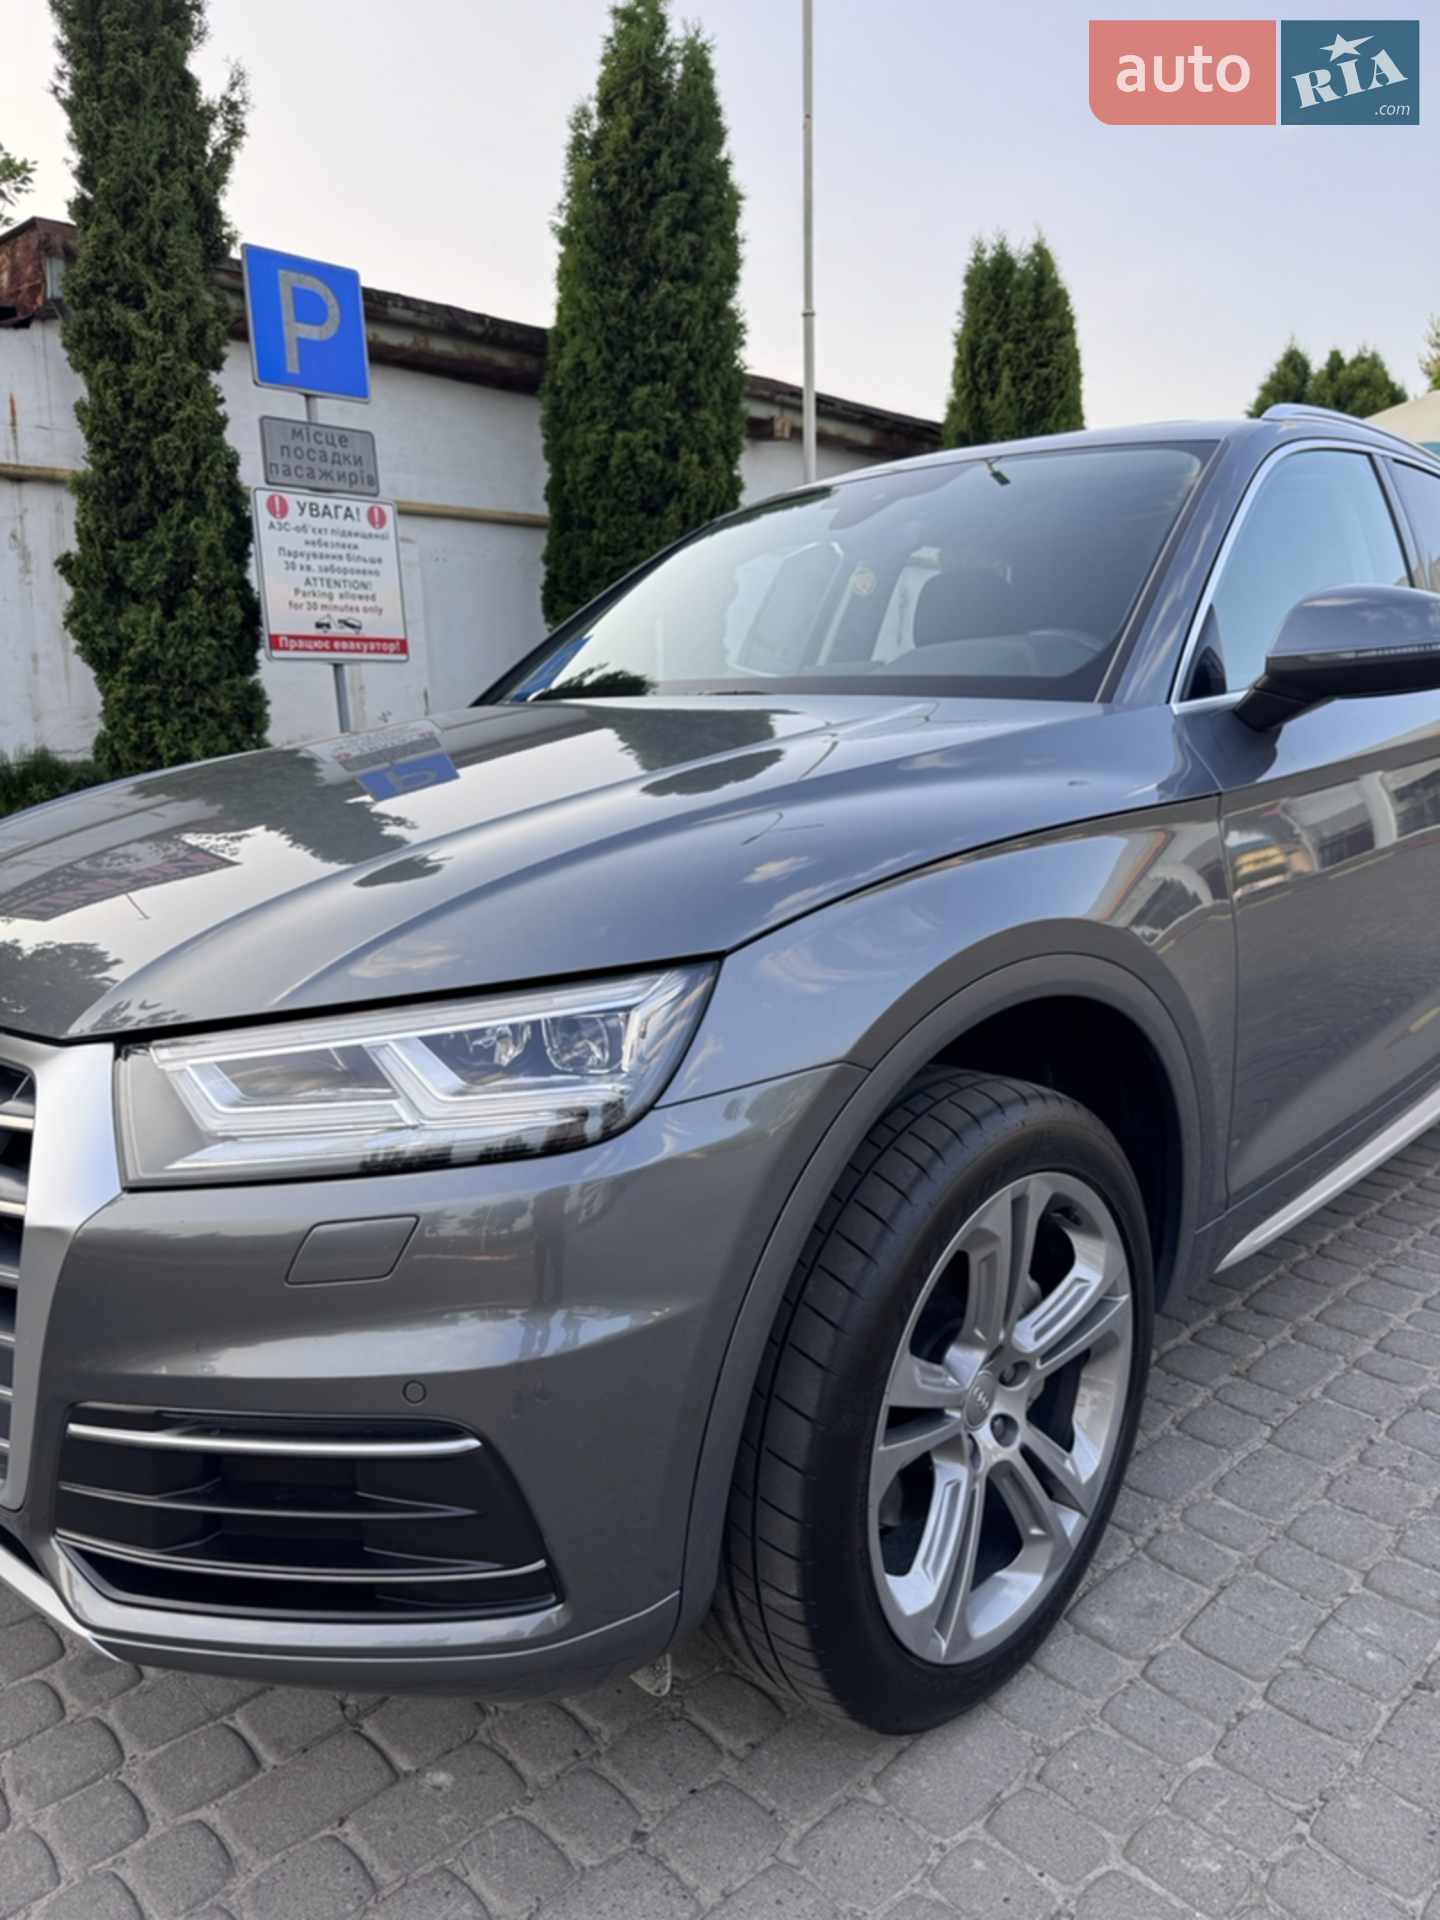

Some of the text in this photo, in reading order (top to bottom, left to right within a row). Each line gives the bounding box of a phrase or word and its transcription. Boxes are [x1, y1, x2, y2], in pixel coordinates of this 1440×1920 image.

[278, 269, 341, 374] P
[280, 445, 363, 467] посадки
[269, 462, 377, 488] пасажирів
[296, 500, 361, 522] УВАГА!
[304, 538, 359, 551] небезпеки
[278, 546, 383, 565] Паркування більше
[284, 561, 297, 572] 30
[317, 563, 381, 577] заборонено
[304, 577, 372, 591] ATTENTION!
[293, 587, 377, 602] Parking allowed
[288, 600, 383, 617] for 30 minutes only
[278, 636, 400, 653] Працює евакуатор!
